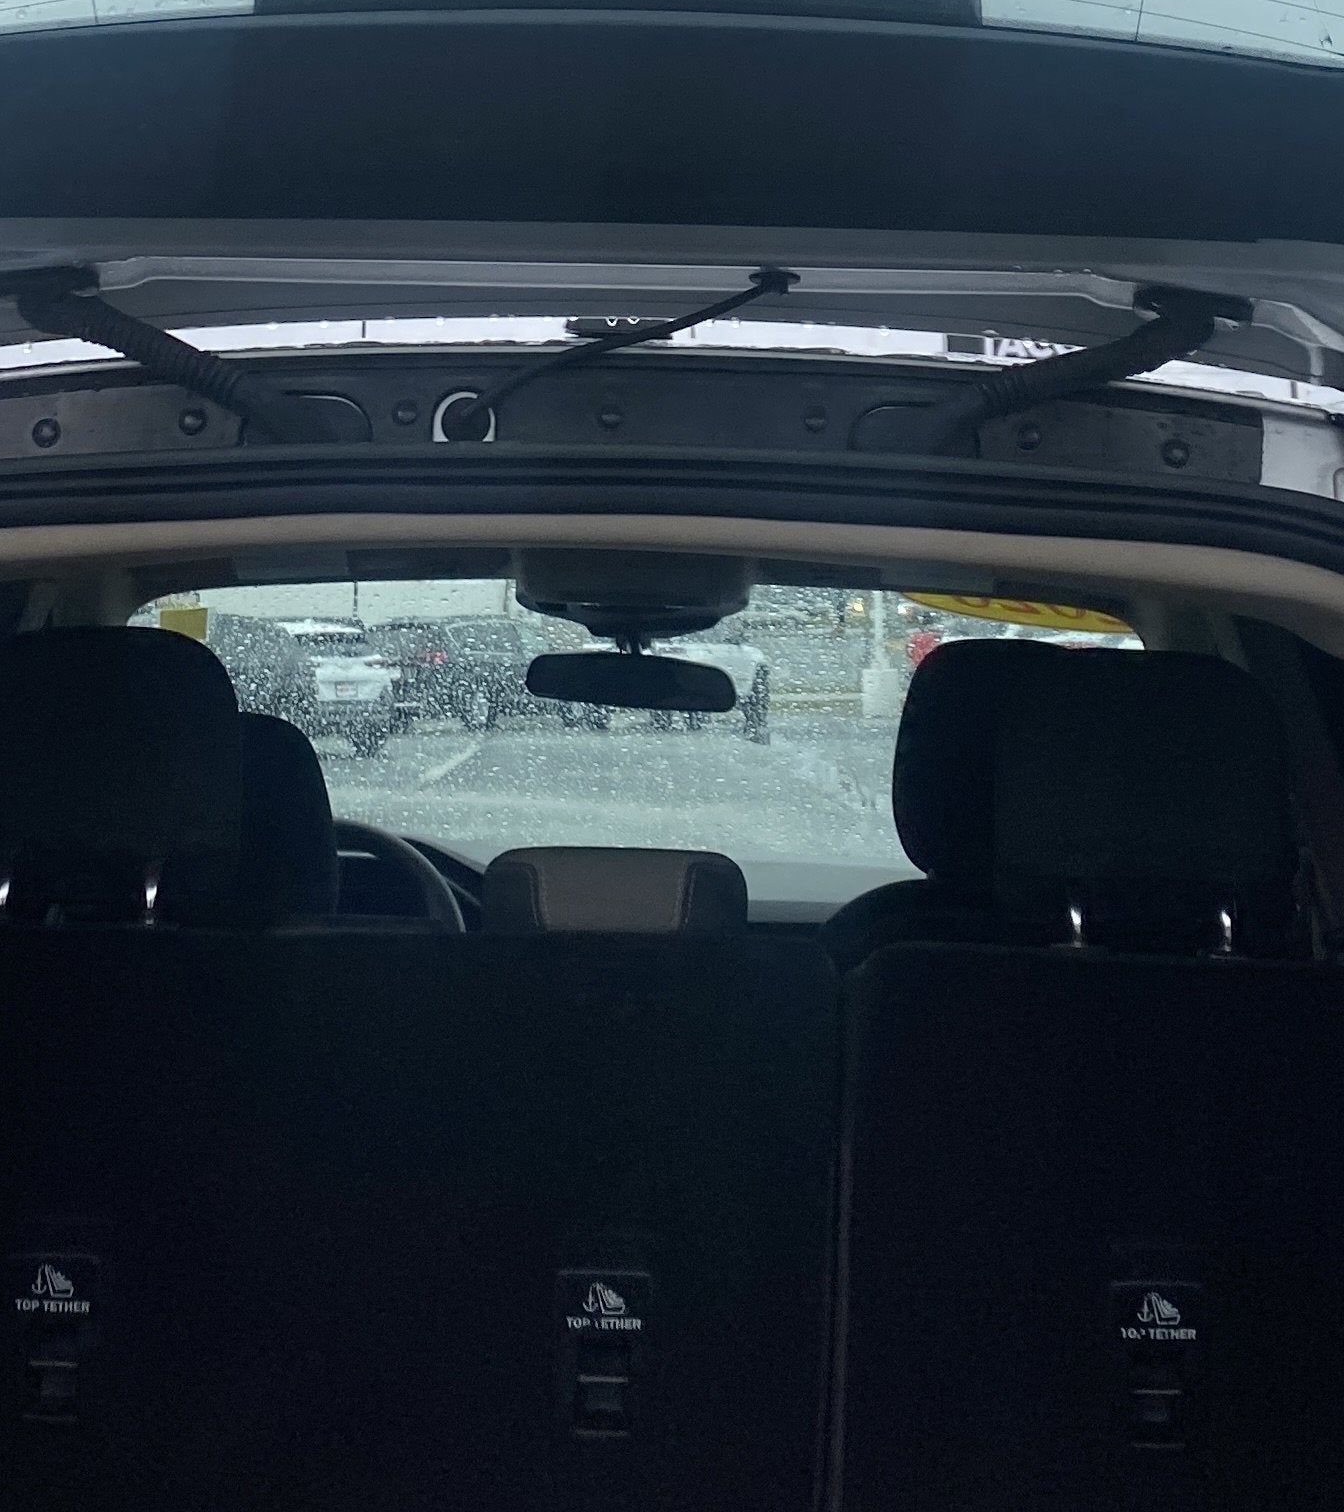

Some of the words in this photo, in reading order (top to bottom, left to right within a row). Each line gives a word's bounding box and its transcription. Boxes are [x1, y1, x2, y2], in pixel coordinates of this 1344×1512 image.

[14, 1298, 40, 1311] TOP
[43, 1299, 90, 1313] TETHER
[566, 1316, 591, 1329] TOP
[1148, 1328, 1197, 1340] TETHER
